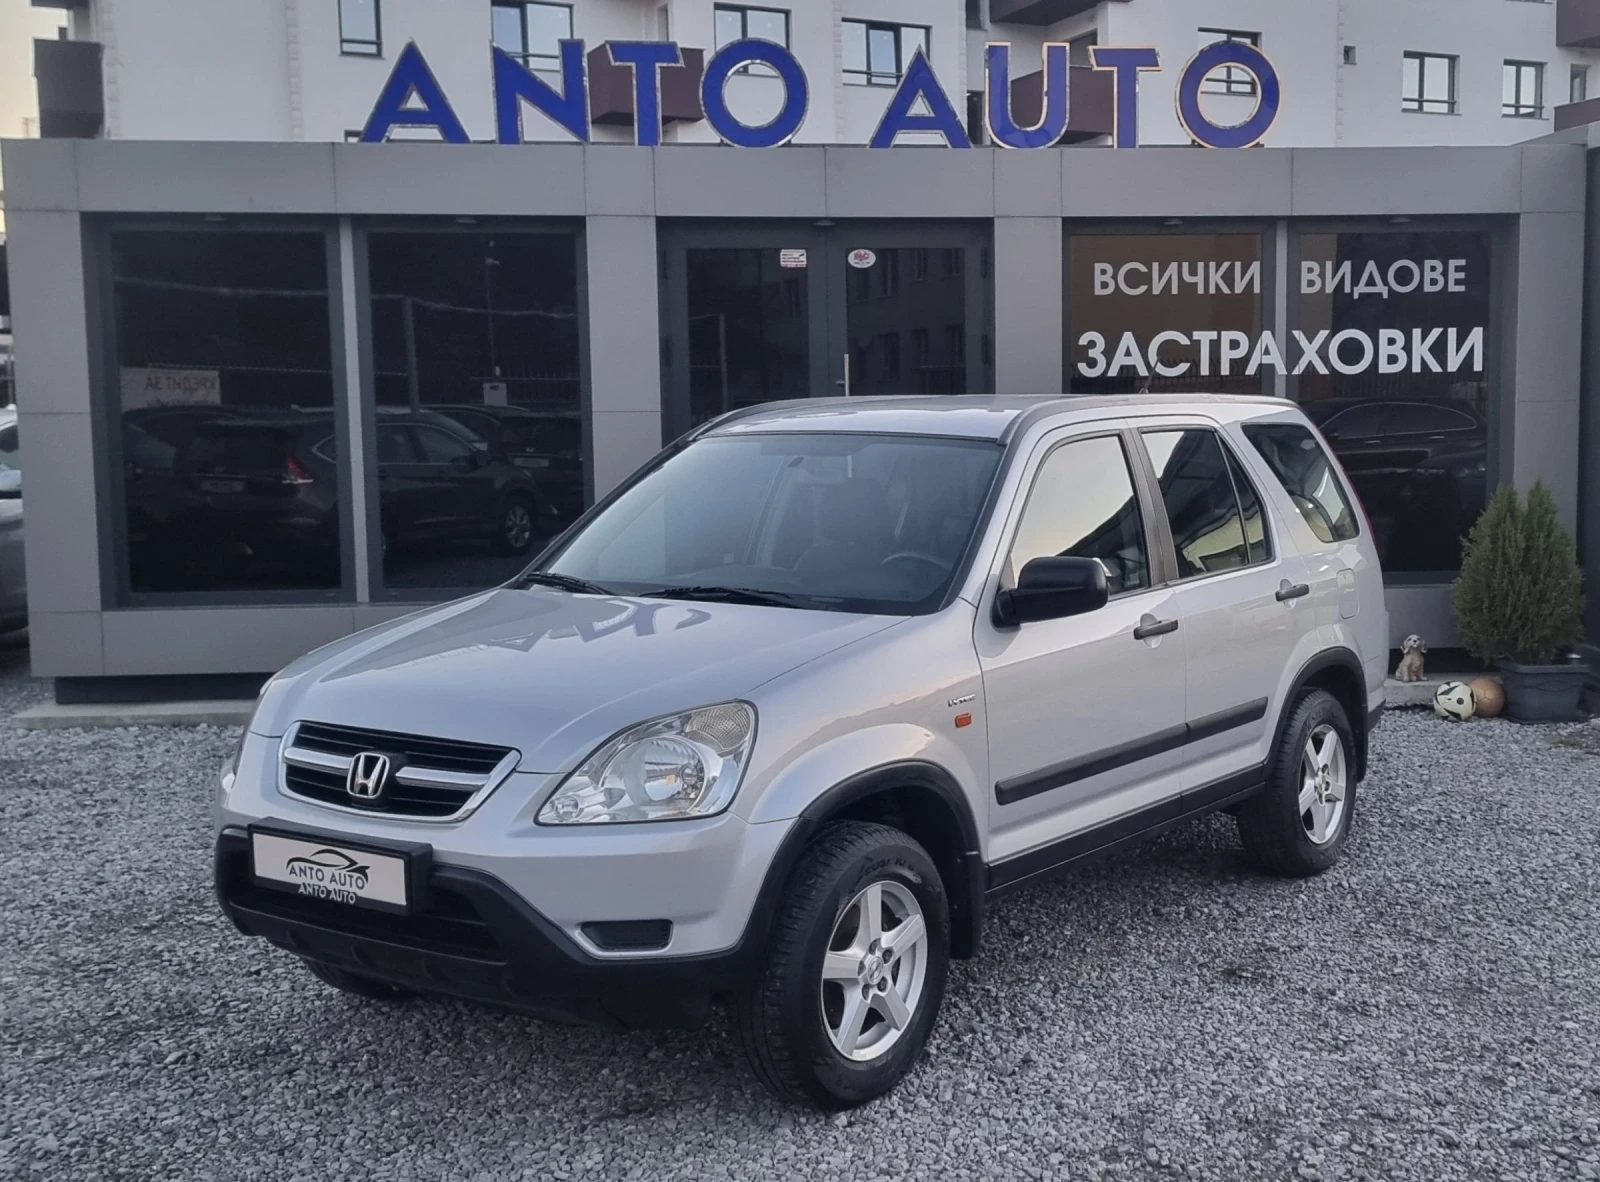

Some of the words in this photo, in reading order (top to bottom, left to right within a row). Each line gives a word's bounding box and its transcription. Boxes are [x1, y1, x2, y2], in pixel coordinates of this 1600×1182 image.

[357, 37, 810, 147] ANTO
[867, 40, 1281, 149] AUTO
[1093, 261, 1262, 296] ВСИЧКИ
[1300, 259, 1467, 299] ВИДОВЕ
[1076, 326, 1485, 378] ЗАСТРАХОВКИ
[288, 864, 325, 882] ANTO
[329, 871, 366, 890] AUTO
[298, 882, 327, 898] ANTO
[329, 888, 356, 905] AUTO
